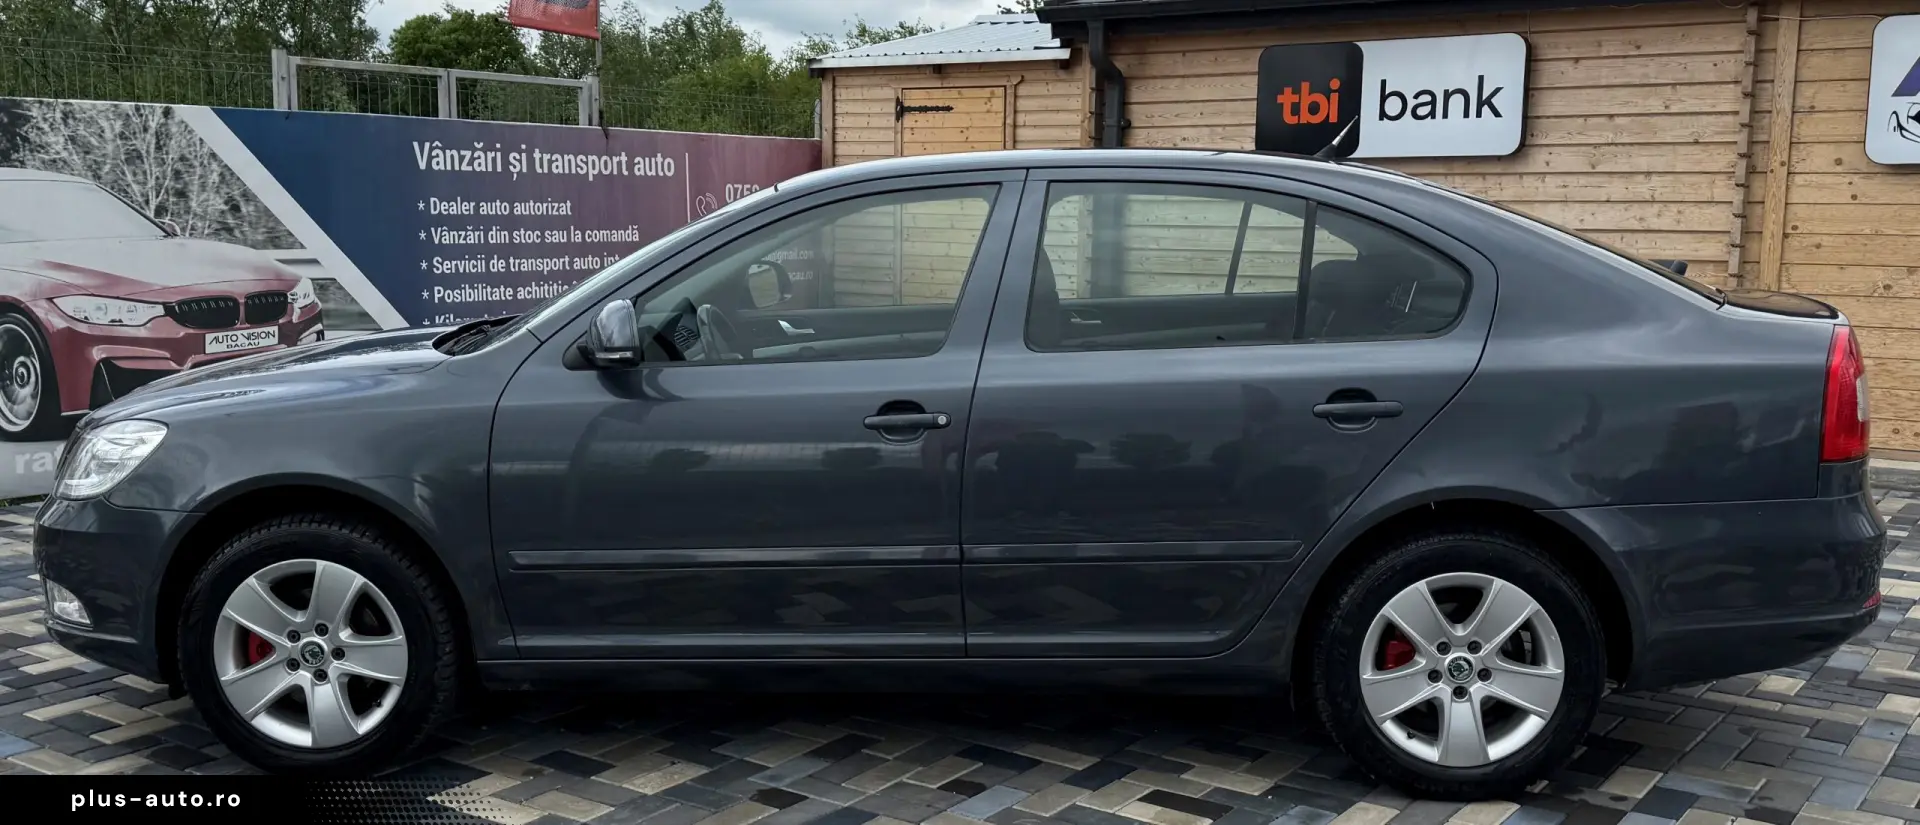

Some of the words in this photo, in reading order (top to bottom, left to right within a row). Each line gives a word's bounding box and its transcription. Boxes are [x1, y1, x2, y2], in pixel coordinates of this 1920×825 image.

[1277, 78, 1341, 125] tbi
[1378, 75, 1504, 121] bank
[412, 140, 502, 171] Vânzări
[508, 144, 527, 181] și
[533, 148, 628, 181] transport
[634, 152, 675, 177] auto
[430, 196, 476, 215] Dealer
[479, 199, 510, 215] auto
[513, 197, 572, 215] autorizat
[430, 225, 484, 244] Vânzări
[488, 226, 510, 244] din
[512, 229, 541, 243] stoc
[544, 230, 567, 243] sau
[570, 226, 582, 242] la
[585, 224, 640, 242] comandă
[432, 254, 486, 274] Servicii
[489, 255, 507, 272] de
[509, 255, 570, 275] transport
[573, 254, 601, 270] auto
[603, 252, 621, 267] int
[434, 284, 513, 304] Posibilitate
[208, 333, 239, 345] AUTO
[241, 330, 276, 341] VISION
